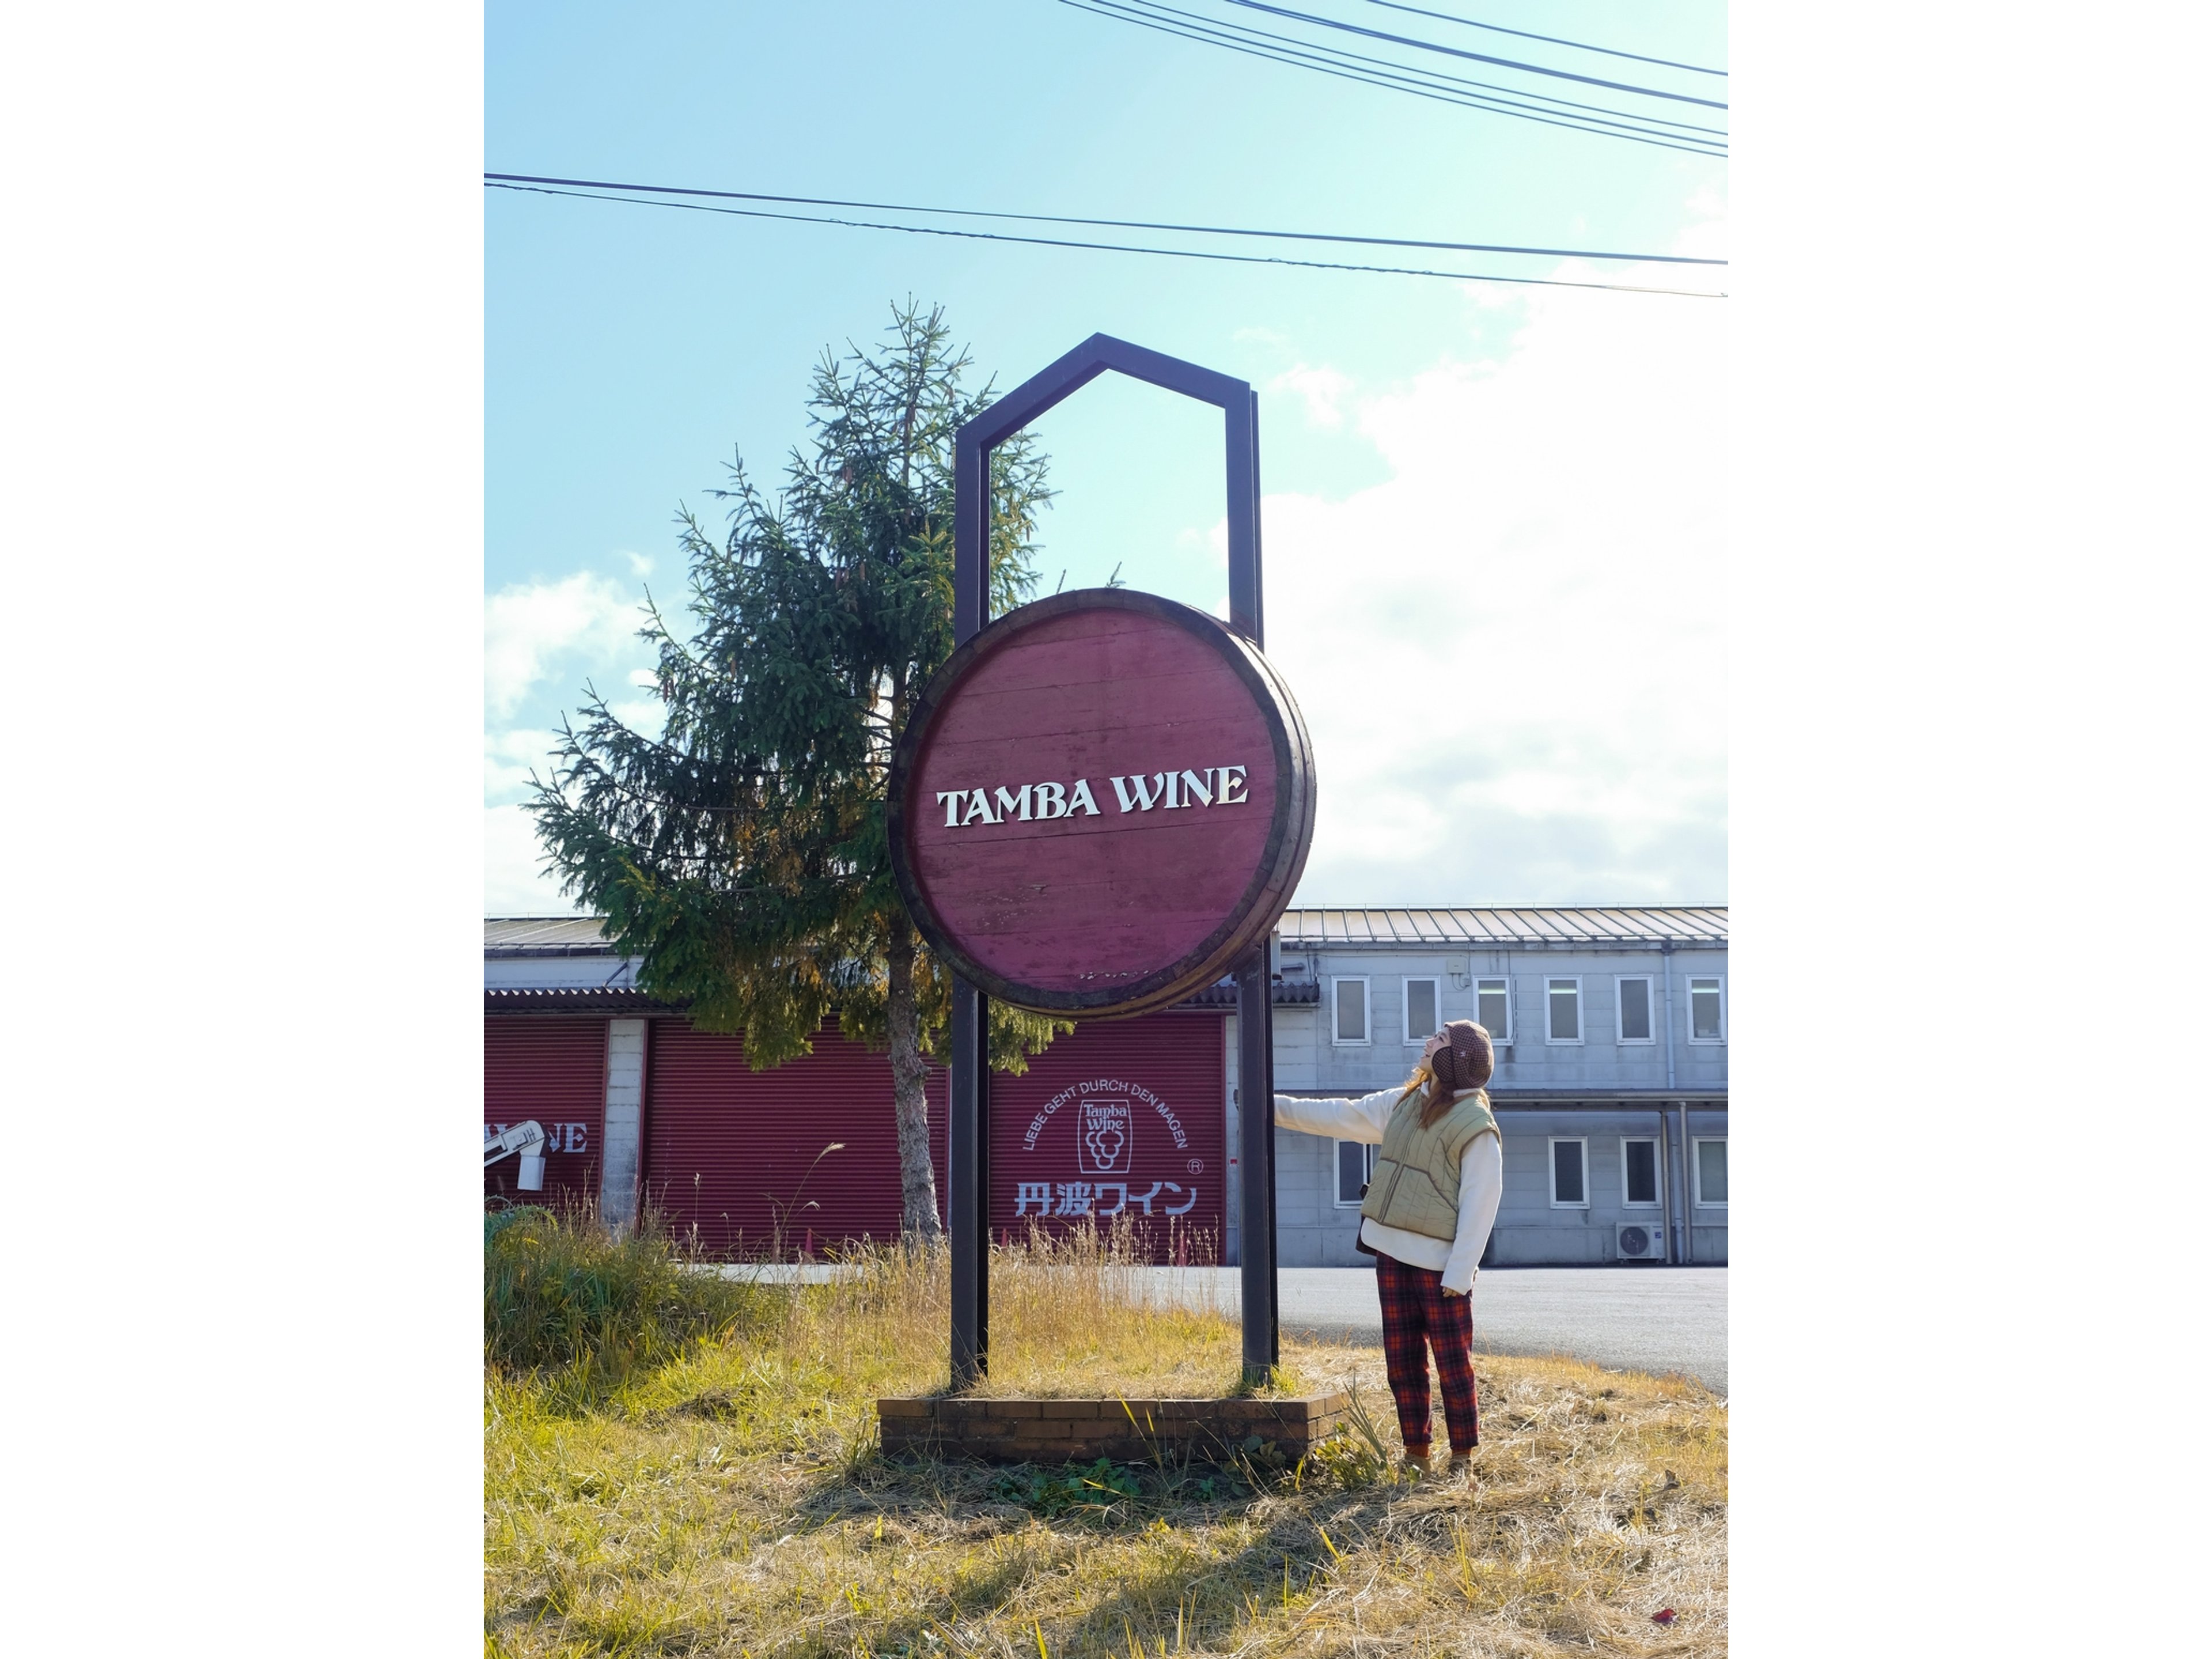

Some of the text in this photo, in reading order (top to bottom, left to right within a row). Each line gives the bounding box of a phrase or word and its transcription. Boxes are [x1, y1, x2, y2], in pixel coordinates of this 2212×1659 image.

[937, 764, 1249, 828] TAMBA WINE
[1022, 1079, 1188, 1151] LIEBE GEHT DURCH DEN MAGEN
[1084, 1103, 1127, 1119] Tamba
[1086, 1117, 1125, 1134] Wine
[1014, 1181, 1198, 1217] 丹波ワイン
